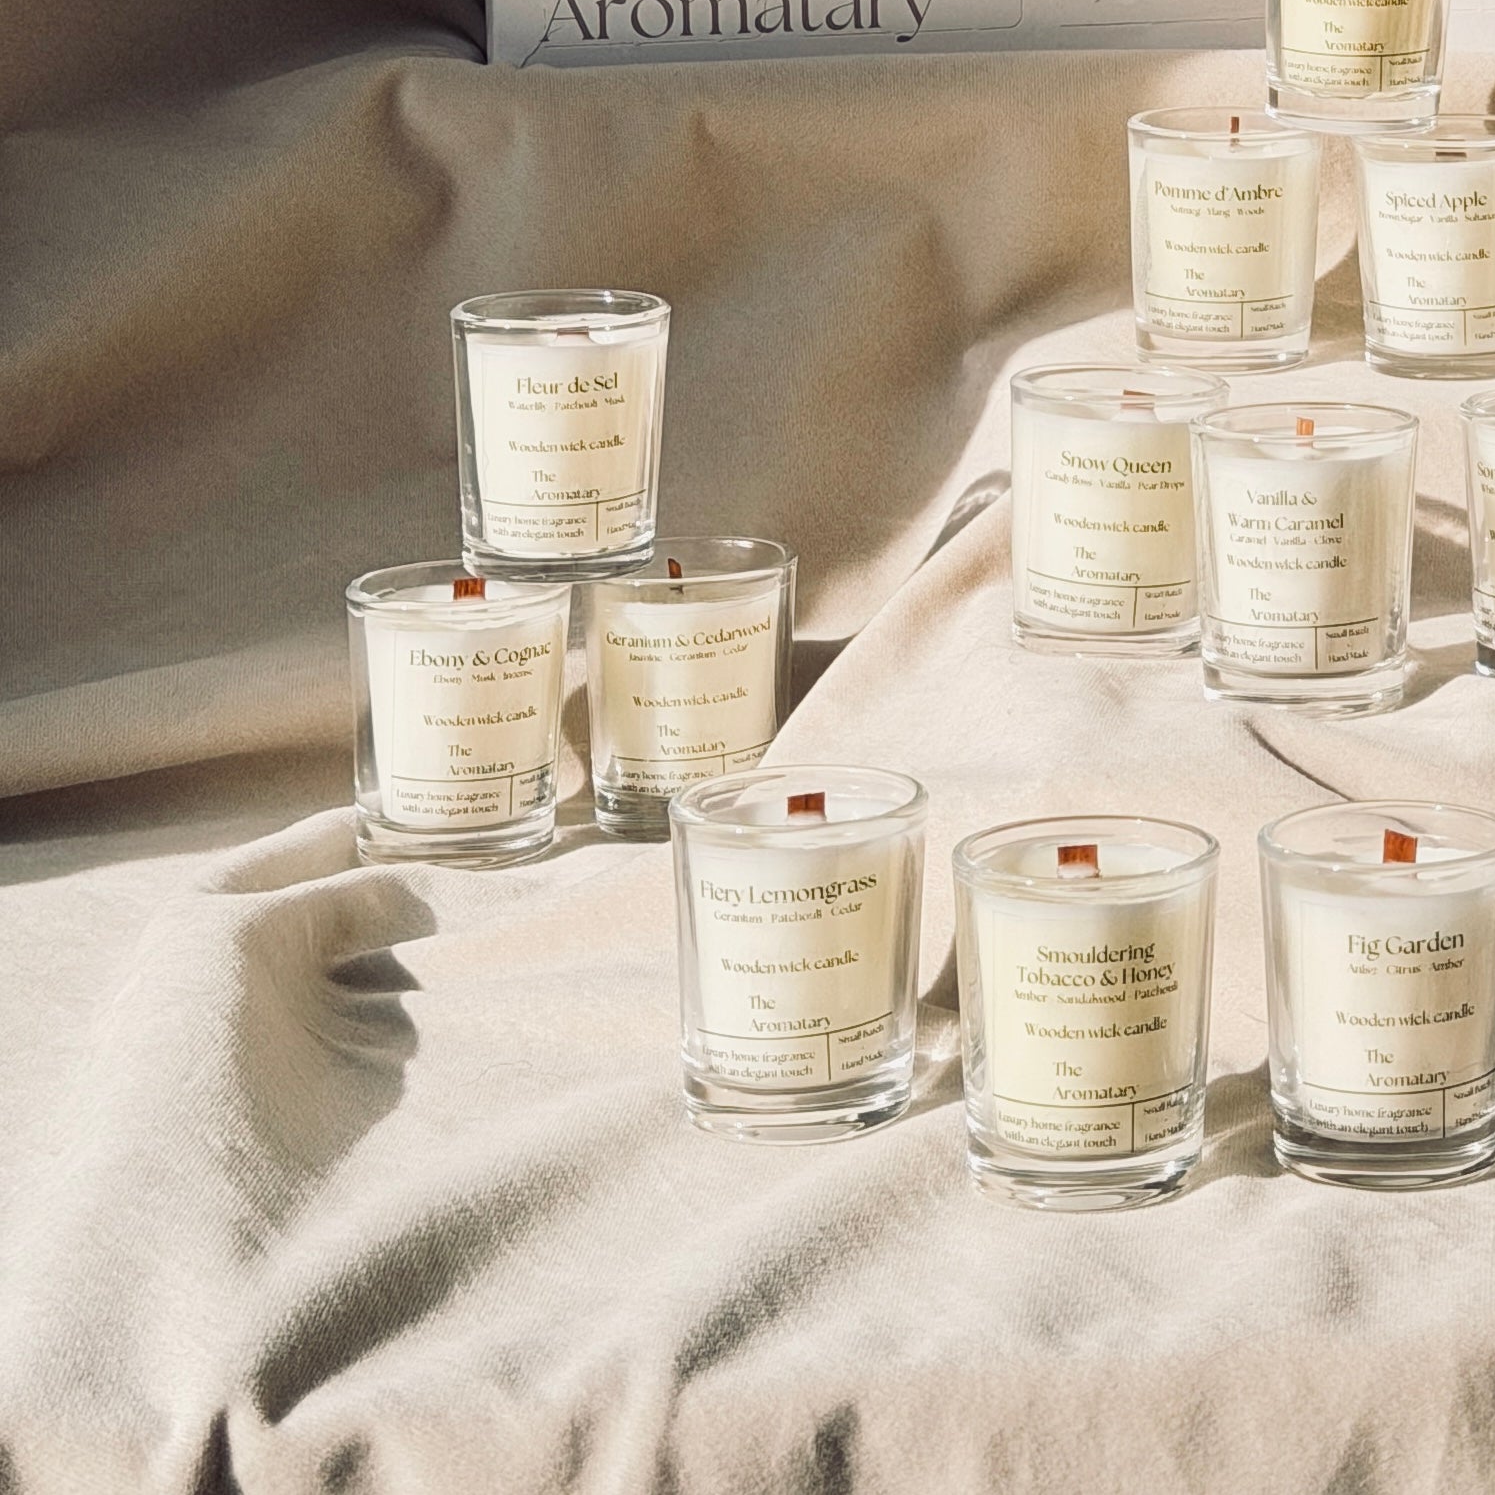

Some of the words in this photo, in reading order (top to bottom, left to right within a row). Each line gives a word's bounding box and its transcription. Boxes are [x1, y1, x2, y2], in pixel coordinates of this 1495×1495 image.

[1154, 180, 1211, 202] Pomme
[1385, 191, 1436, 211] Spiced
[1440, 191, 1488, 212] Apple
[517, 377, 563, 395] Fleur
[567, 376, 590, 394] de
[593, 372, 618, 392] Sel
[1061, 450, 1108, 472] Snow
[1112, 457, 1172, 477] Queen
[532, 470, 556, 483] The
[1246, 489, 1298, 506] Vanilla
[1301, 491, 1318, 506] &
[1228, 512, 1272, 531] Warm
[1274, 512, 1344, 531] Caramel
[1073, 546, 1097, 560] The
[1248, 588, 1272, 601] The
[606, 631, 672, 648] Geranium
[693, 615, 771, 646] Cedarwood
[409, 648, 468, 671] Ebony
[472, 650, 490, 666] &
[494, 641, 552, 666] Cognac
[447, 744, 473, 757] The
[700, 879, 743, 907] Fiery
[749, 873, 877, 905] Lemongrass
[1036, 943, 1155, 964] Smouldering
[1347, 934, 1381, 961] Fig
[1385, 931, 1465, 956] Garden
[721, 958, 776, 974] Wooden
[1016, 965, 1095, 986] Tobacco
[1100, 969, 1118, 986] &
[1122, 962, 1176, 985] Honey
[749, 995, 776, 1010] The
[1335, 1010, 1396, 1027] Wooden
[1025, 1021, 1085, 1039] Wooden
[1364, 1048, 1394, 1064] The
[1054, 1061, 1082, 1077] The
